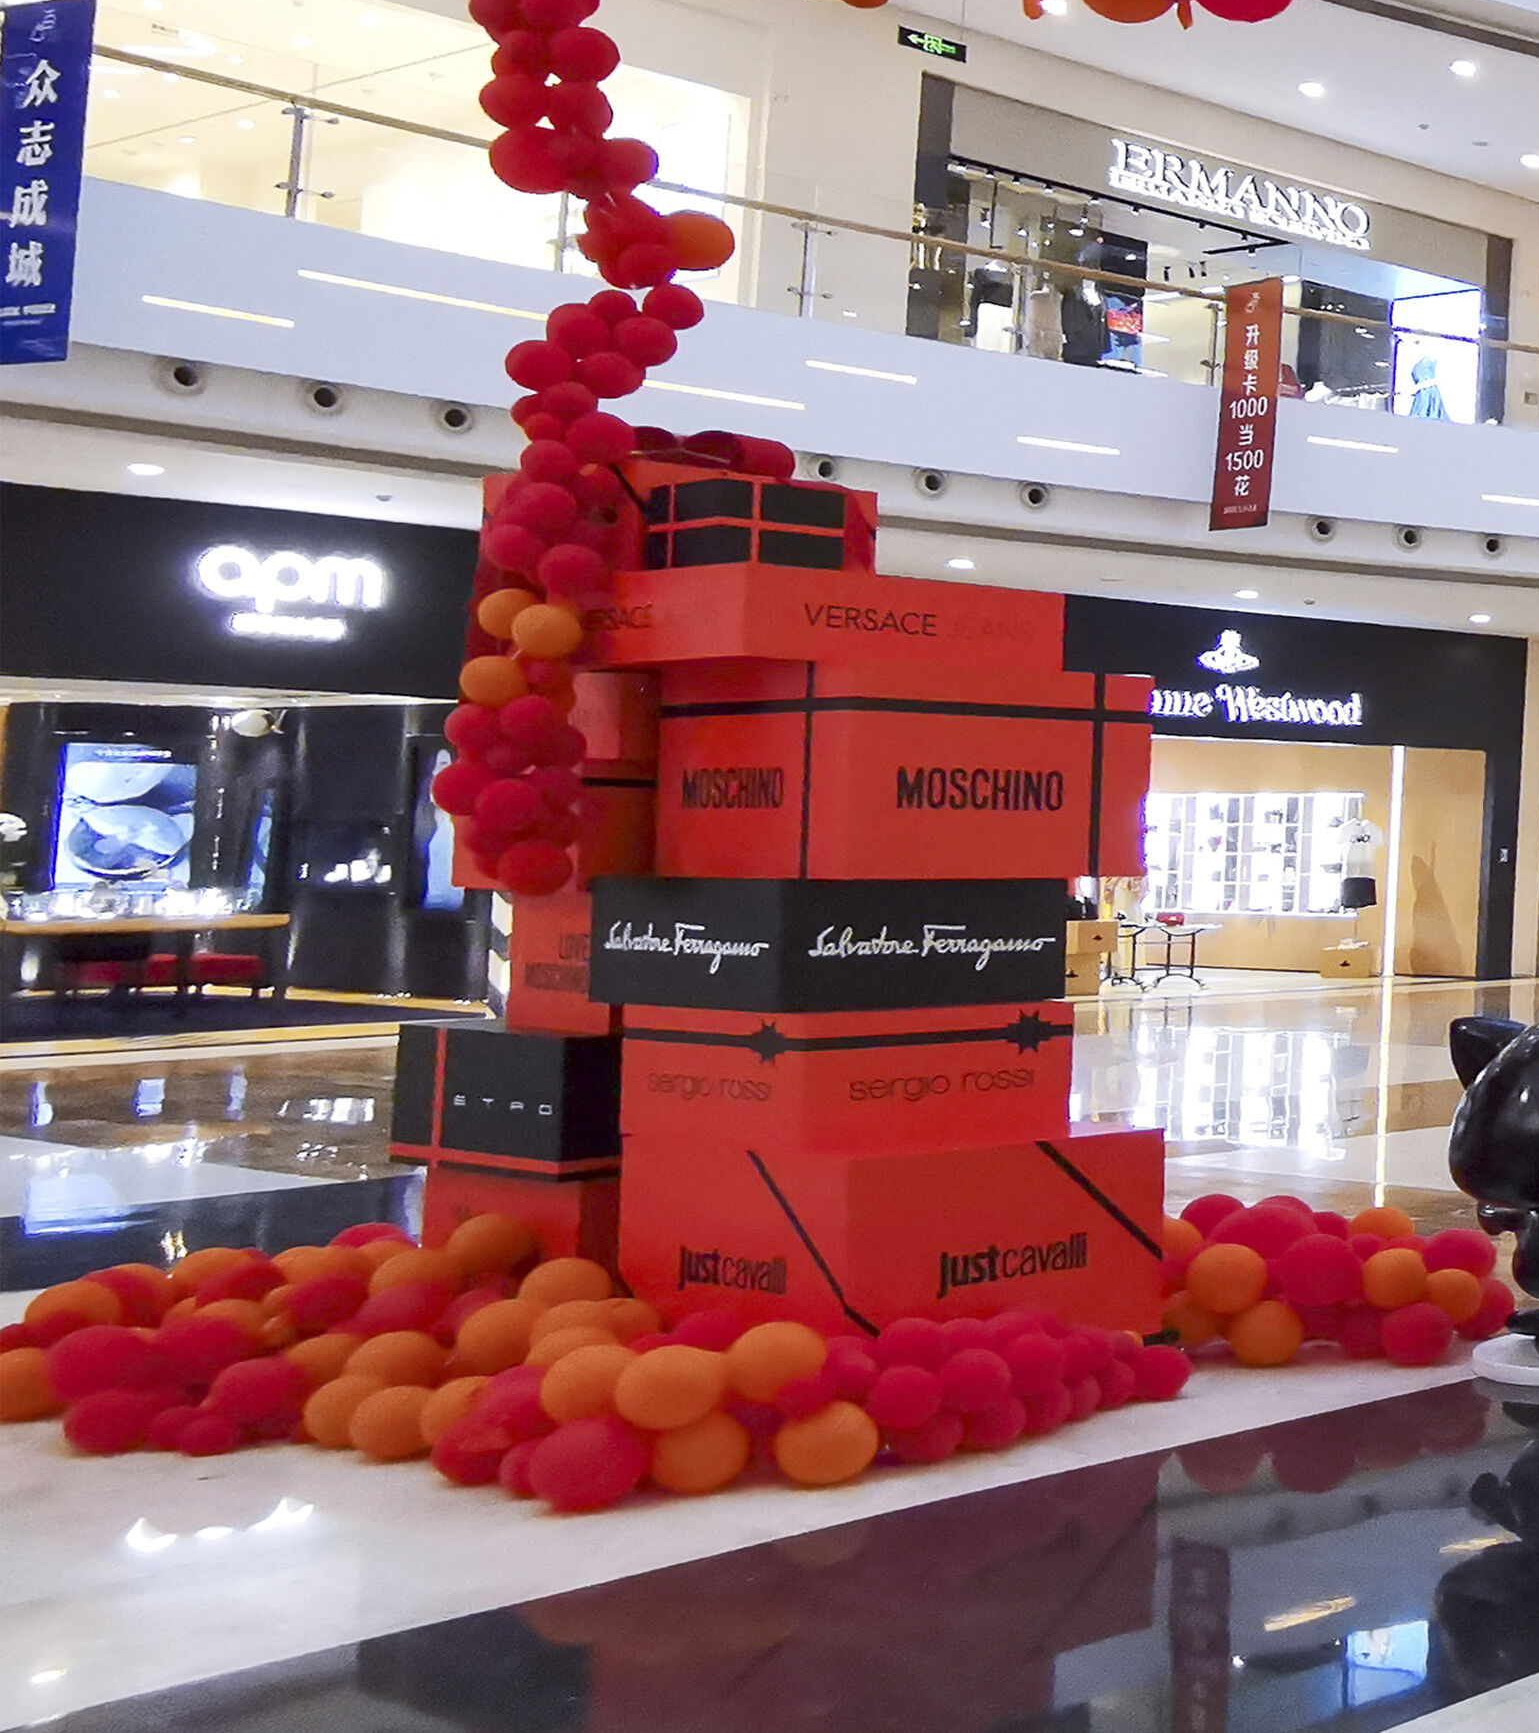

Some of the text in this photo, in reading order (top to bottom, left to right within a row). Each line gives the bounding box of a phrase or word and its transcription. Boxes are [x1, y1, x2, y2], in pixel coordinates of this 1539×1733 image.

[5, 59, 60, 287] 众志成城
[1110, 138, 1371, 237] ERMANNO
[1243, 324, 1260, 395] 升级卡
[1229, 396, 1268, 419] 1000
[1225, 449, 1264, 471] 1500
[198, 544, 383, 613] apm
[804, 602, 938, 637] VERSACE
[1215, 683, 1363, 725] Westwood
[682, 767, 785, 809] MOSCHINO
[896, 766, 1064, 812] MOSCHINO
[604, 920, 770, 974] Salvatore Ferragamo
[808, 924, 1056, 971] Salvatore Ferragamo
[848, 1067, 1035, 1102] sergio rossi
